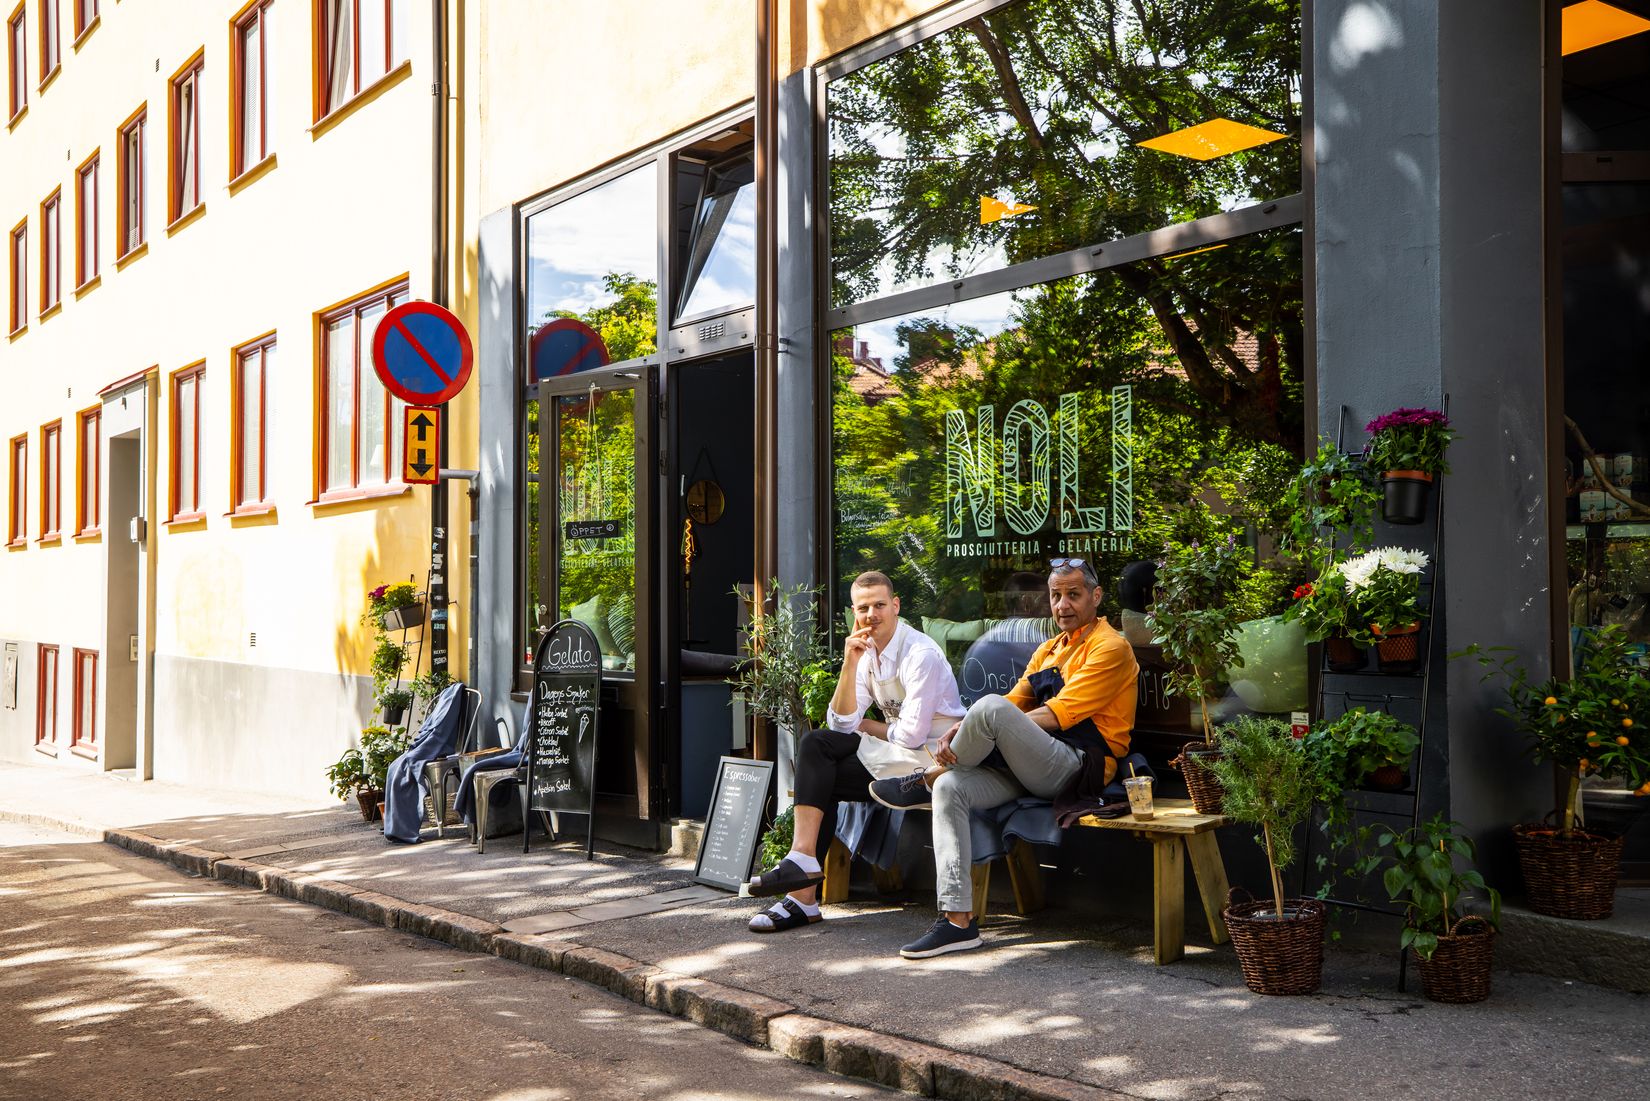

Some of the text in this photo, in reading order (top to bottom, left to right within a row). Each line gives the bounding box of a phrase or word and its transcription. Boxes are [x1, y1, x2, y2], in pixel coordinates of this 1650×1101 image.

[946, 384, 1133, 539] NOLI
[570, 524, 603, 537] ÖPPET
[946, 540, 1040, 557] PROSCIUTTERIA
[1059, 537, 1134, 553] GELATERIA
[548, 636, 592, 666] Gelato
[540, 681, 591, 706] Dagens Smaker
